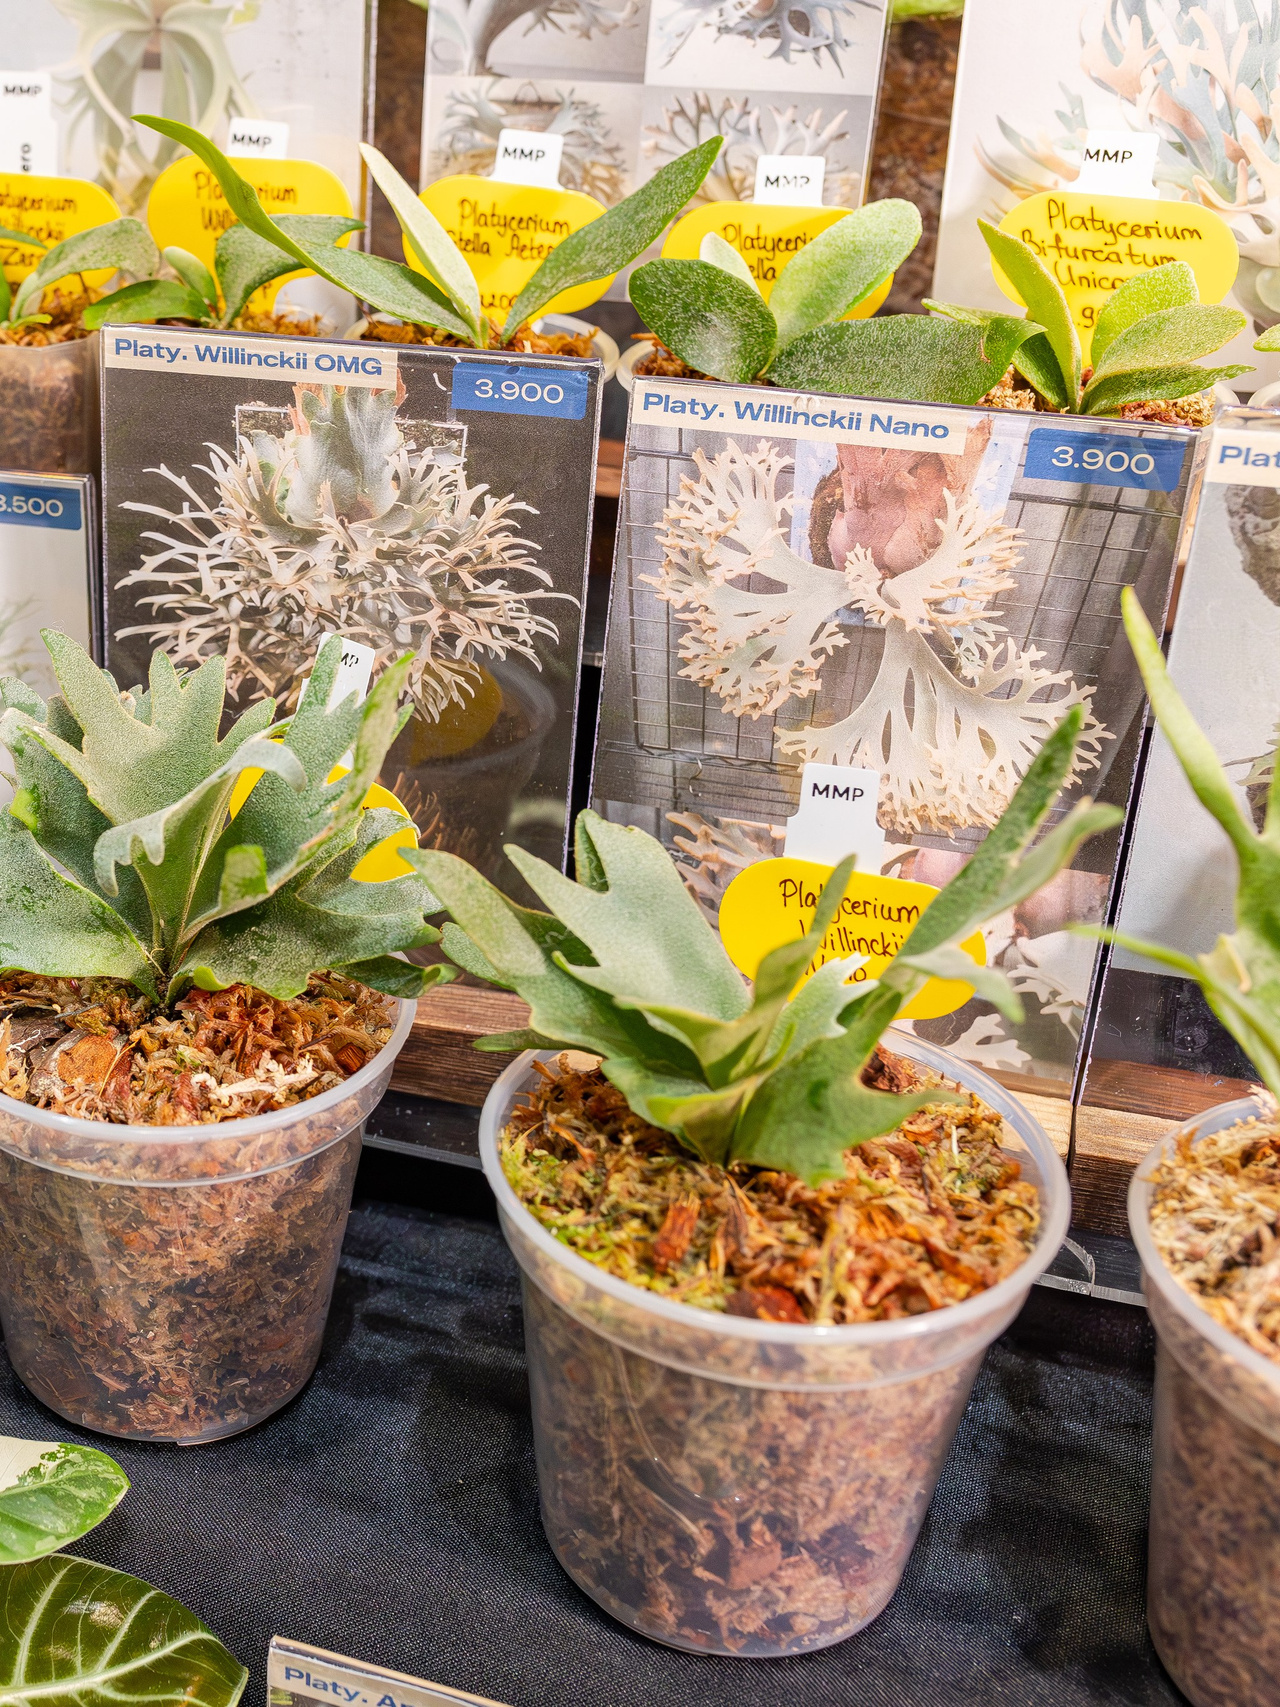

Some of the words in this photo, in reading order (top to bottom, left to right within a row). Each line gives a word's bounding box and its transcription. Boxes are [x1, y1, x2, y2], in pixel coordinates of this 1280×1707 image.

[3, 85, 42, 97] MMP
[231, 134, 273, 149] MMP
[502, 146, 546, 162] MMP
[1084, 148, 1133, 164] MMP
[764, 175, 810, 188] MMP
[459, 198, 570, 238] Platycerium
[1047, 198, 1202, 246] Platycerium
[722, 224, 814, 261] Platyceri
[748, 257, 777, 281] ella
[1054, 261, 1130, 290] Unico
[114, 337, 188, 364] Platy.
[194, 344, 308, 371] Willinckii
[314, 354, 383, 377] OMG
[473, 377, 565, 405] 3.900
[642, 391, 725, 422] Platy.
[732, 400, 863, 433] Willinckii
[869, 412, 951, 441] Nano
[1052, 445, 1156, 477] 3.900
[811, 782, 864, 803] MMP
[284, 1665, 369, 1703] Platy.
